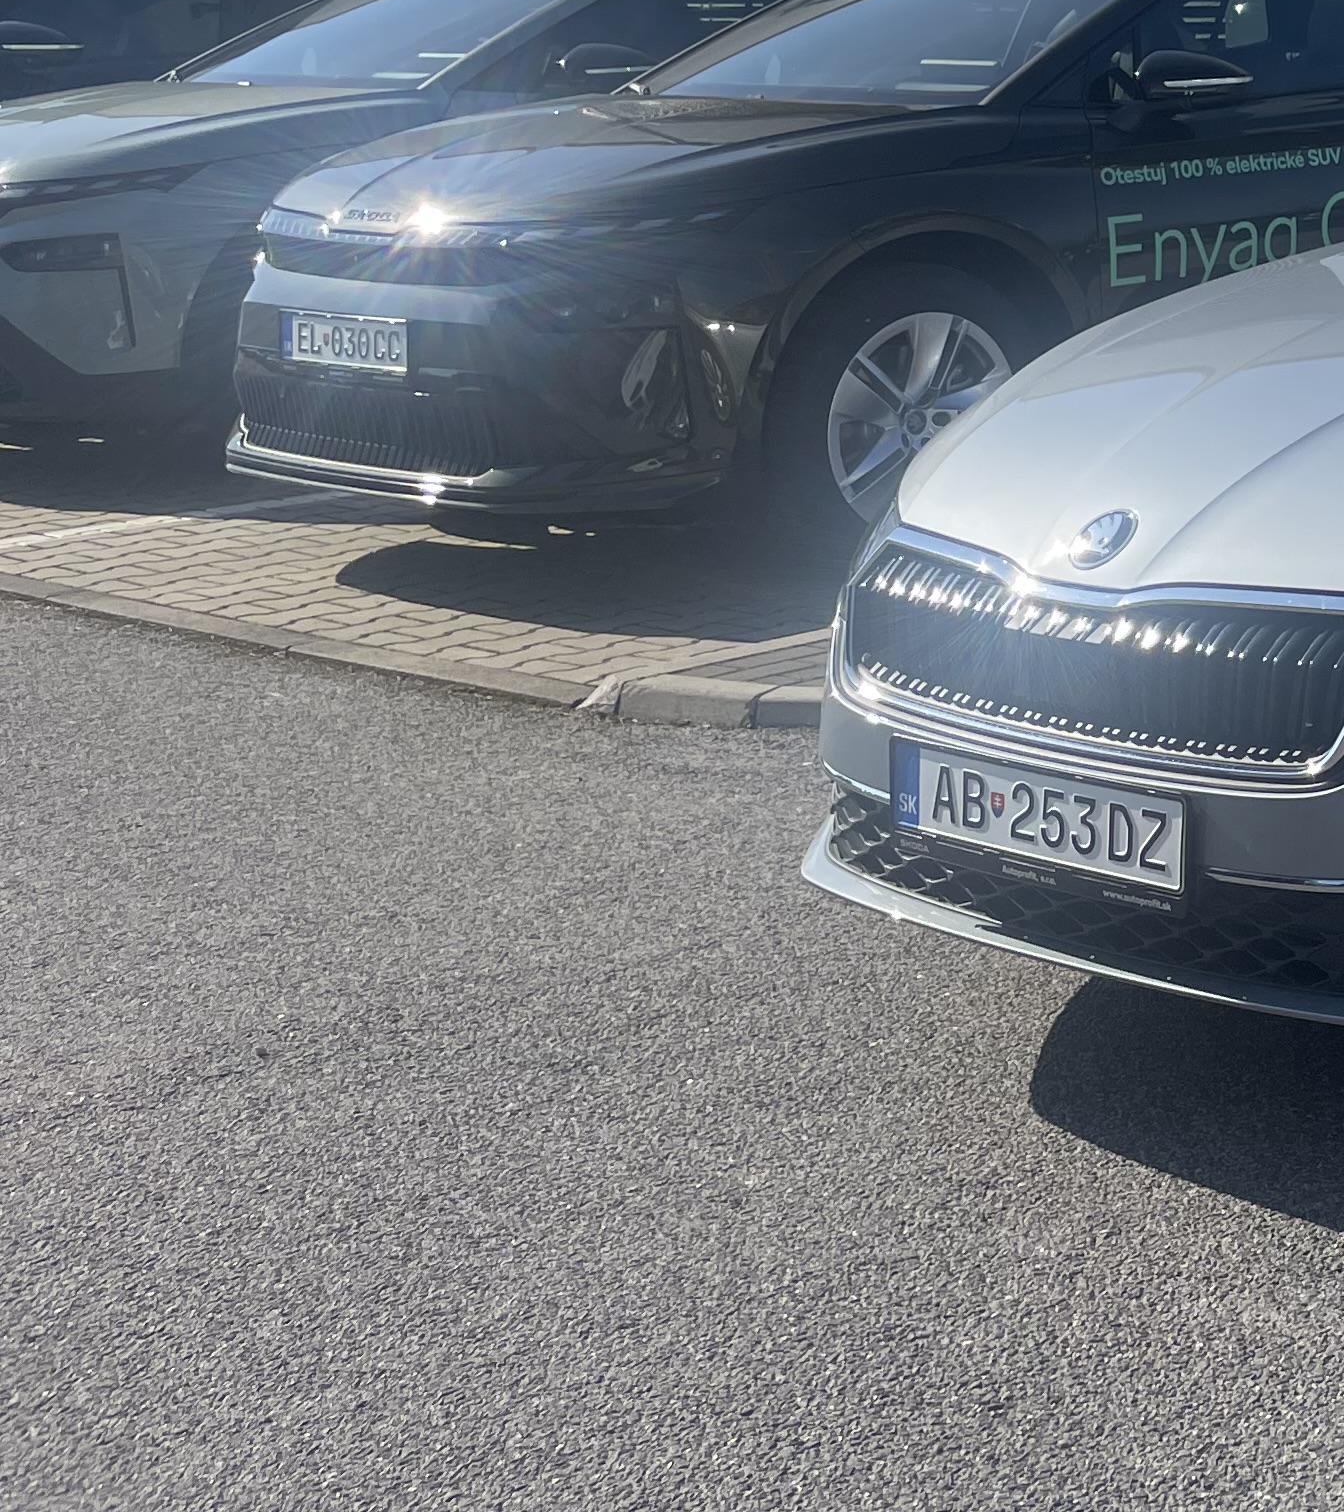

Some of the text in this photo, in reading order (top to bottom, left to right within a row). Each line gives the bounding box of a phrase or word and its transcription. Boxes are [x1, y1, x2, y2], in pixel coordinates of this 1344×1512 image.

[1100, 146, 1342, 186] Otestuj 100 % elektrické SUV
[899, 791, 917, 816] SK
